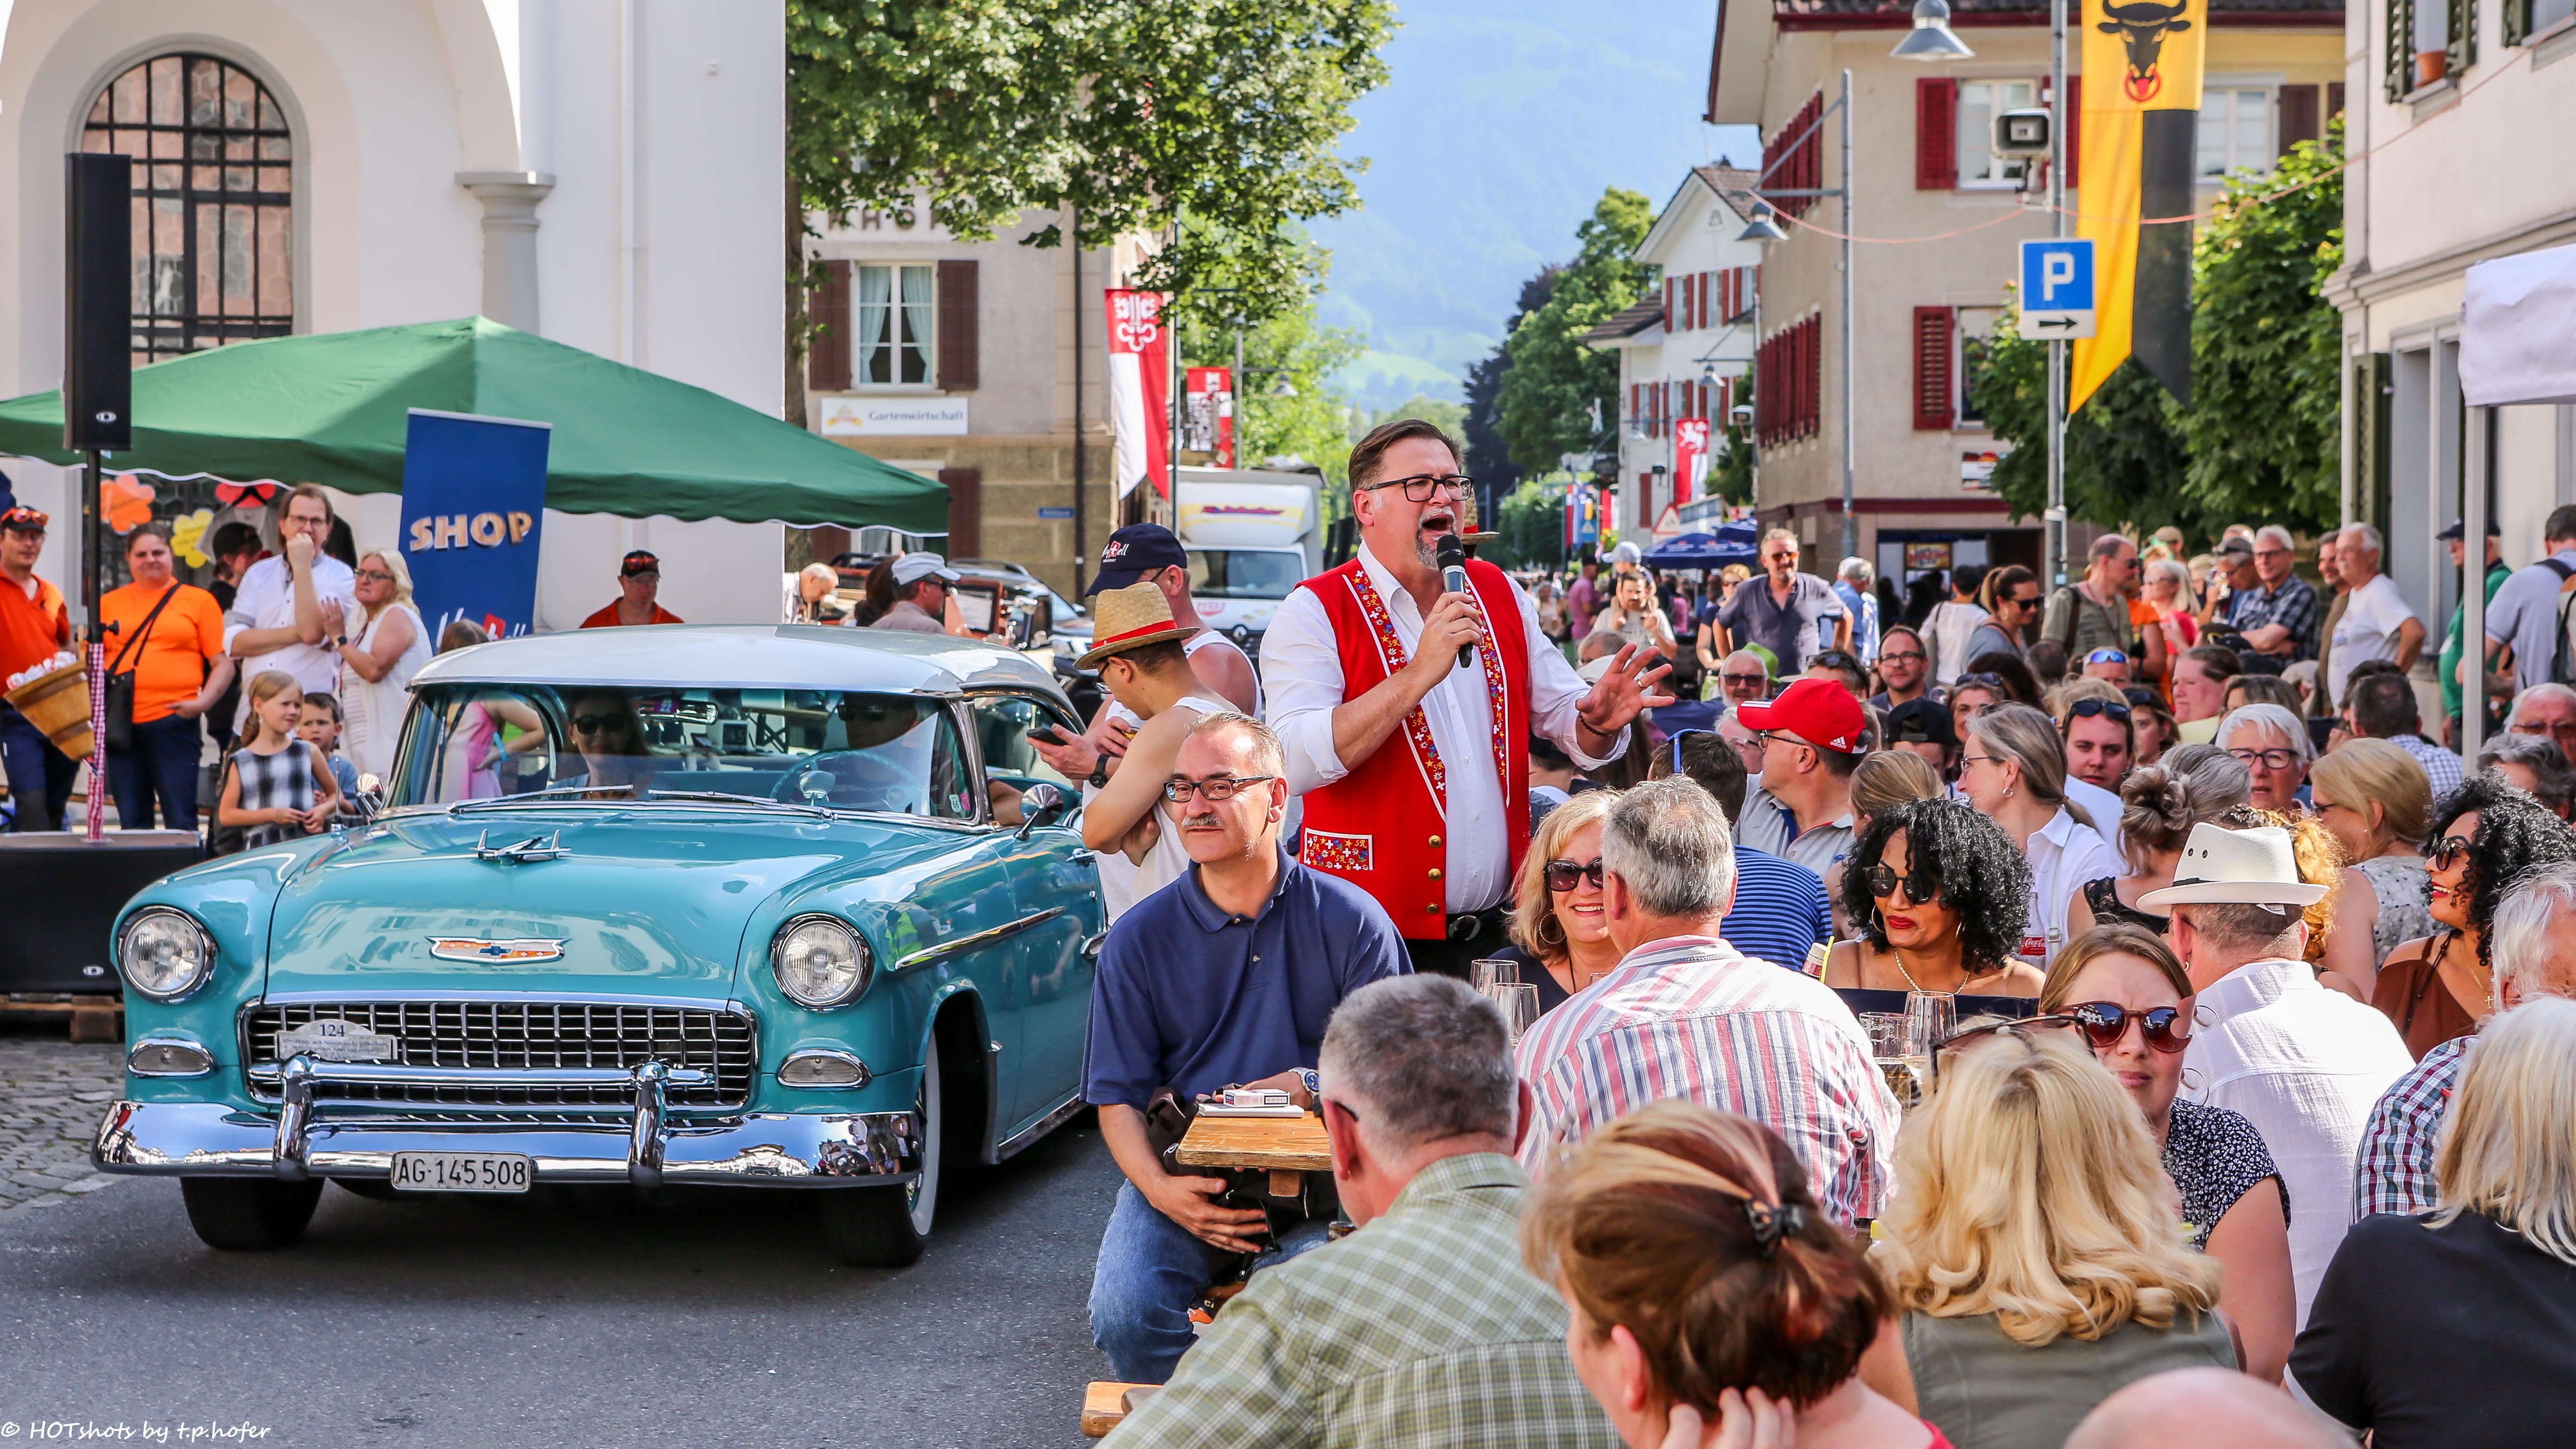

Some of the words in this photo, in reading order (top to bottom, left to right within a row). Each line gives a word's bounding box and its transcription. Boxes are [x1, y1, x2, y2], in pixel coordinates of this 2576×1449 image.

[2043, 252, 2075, 302] P
[869, 410, 964, 421] Gartenwirtschaft
[409, 511, 533, 553] SHOP
[1830, 741, 1847, 749] adidas
[1354, 839, 1368, 848] SR
[1335, 855, 1347, 863] SR
[319, 1024, 345, 1037] 124
